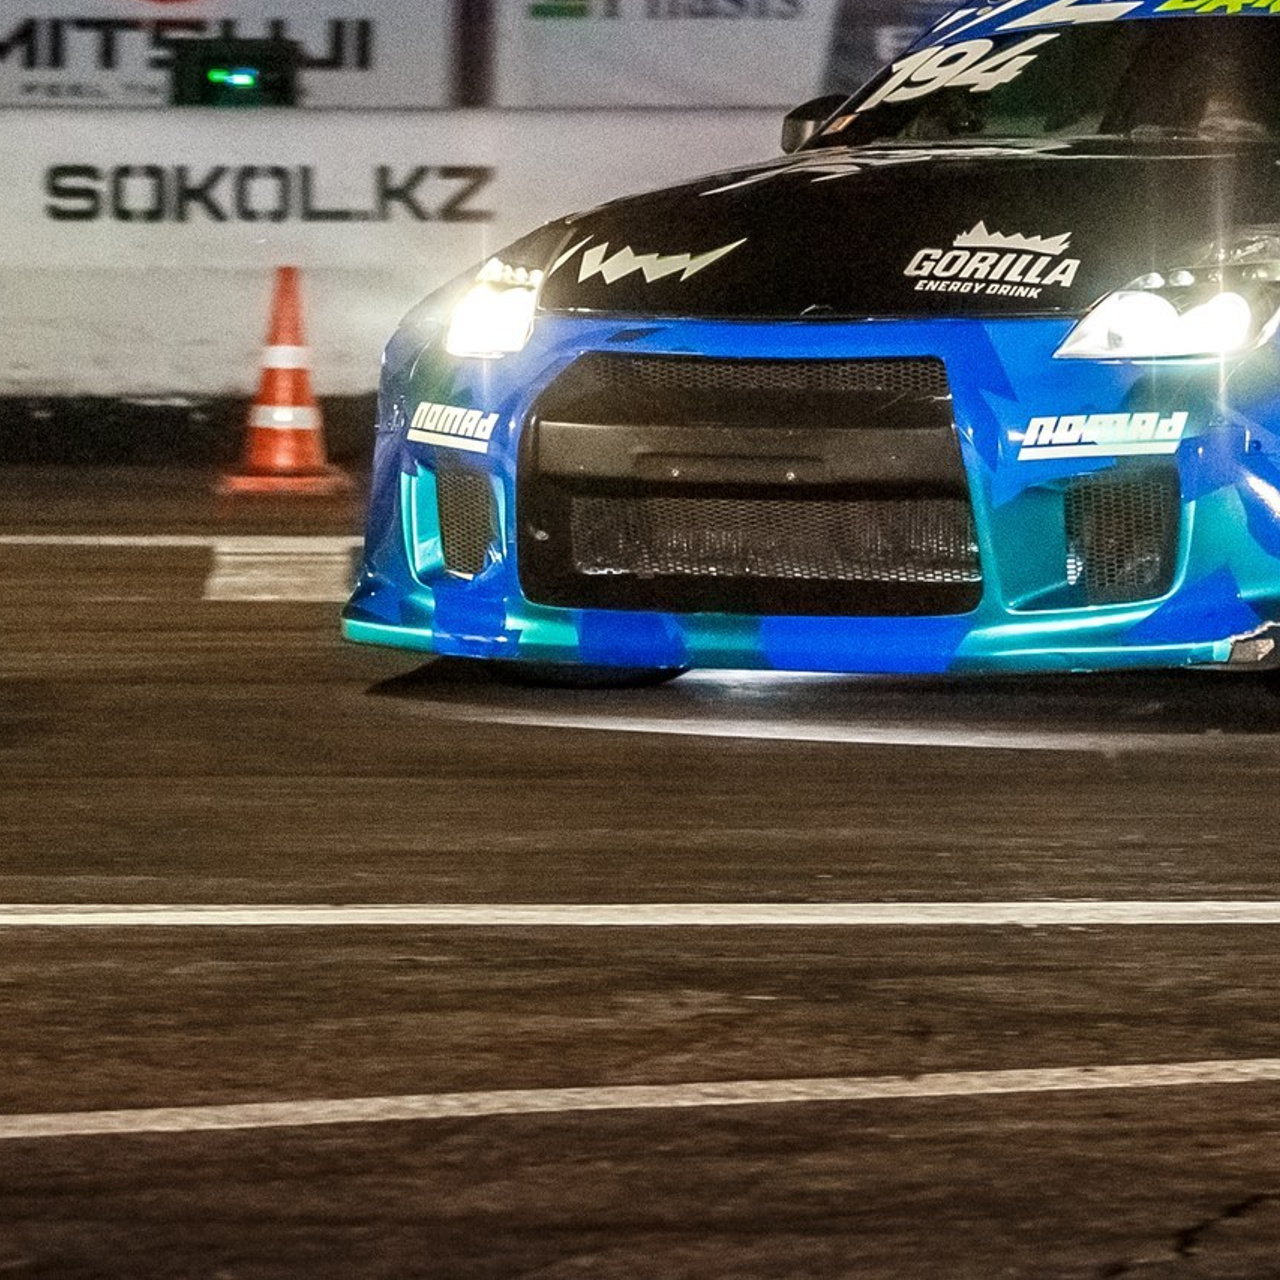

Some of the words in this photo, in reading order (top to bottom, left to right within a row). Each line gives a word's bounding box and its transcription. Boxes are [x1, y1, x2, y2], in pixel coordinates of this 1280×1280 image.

[855, 32, 1061, 113] 194
[903, 247, 1081, 288] GORILLA
[914, 279, 986, 294] ENERGY
[985, 283, 1043, 299] DRINK
